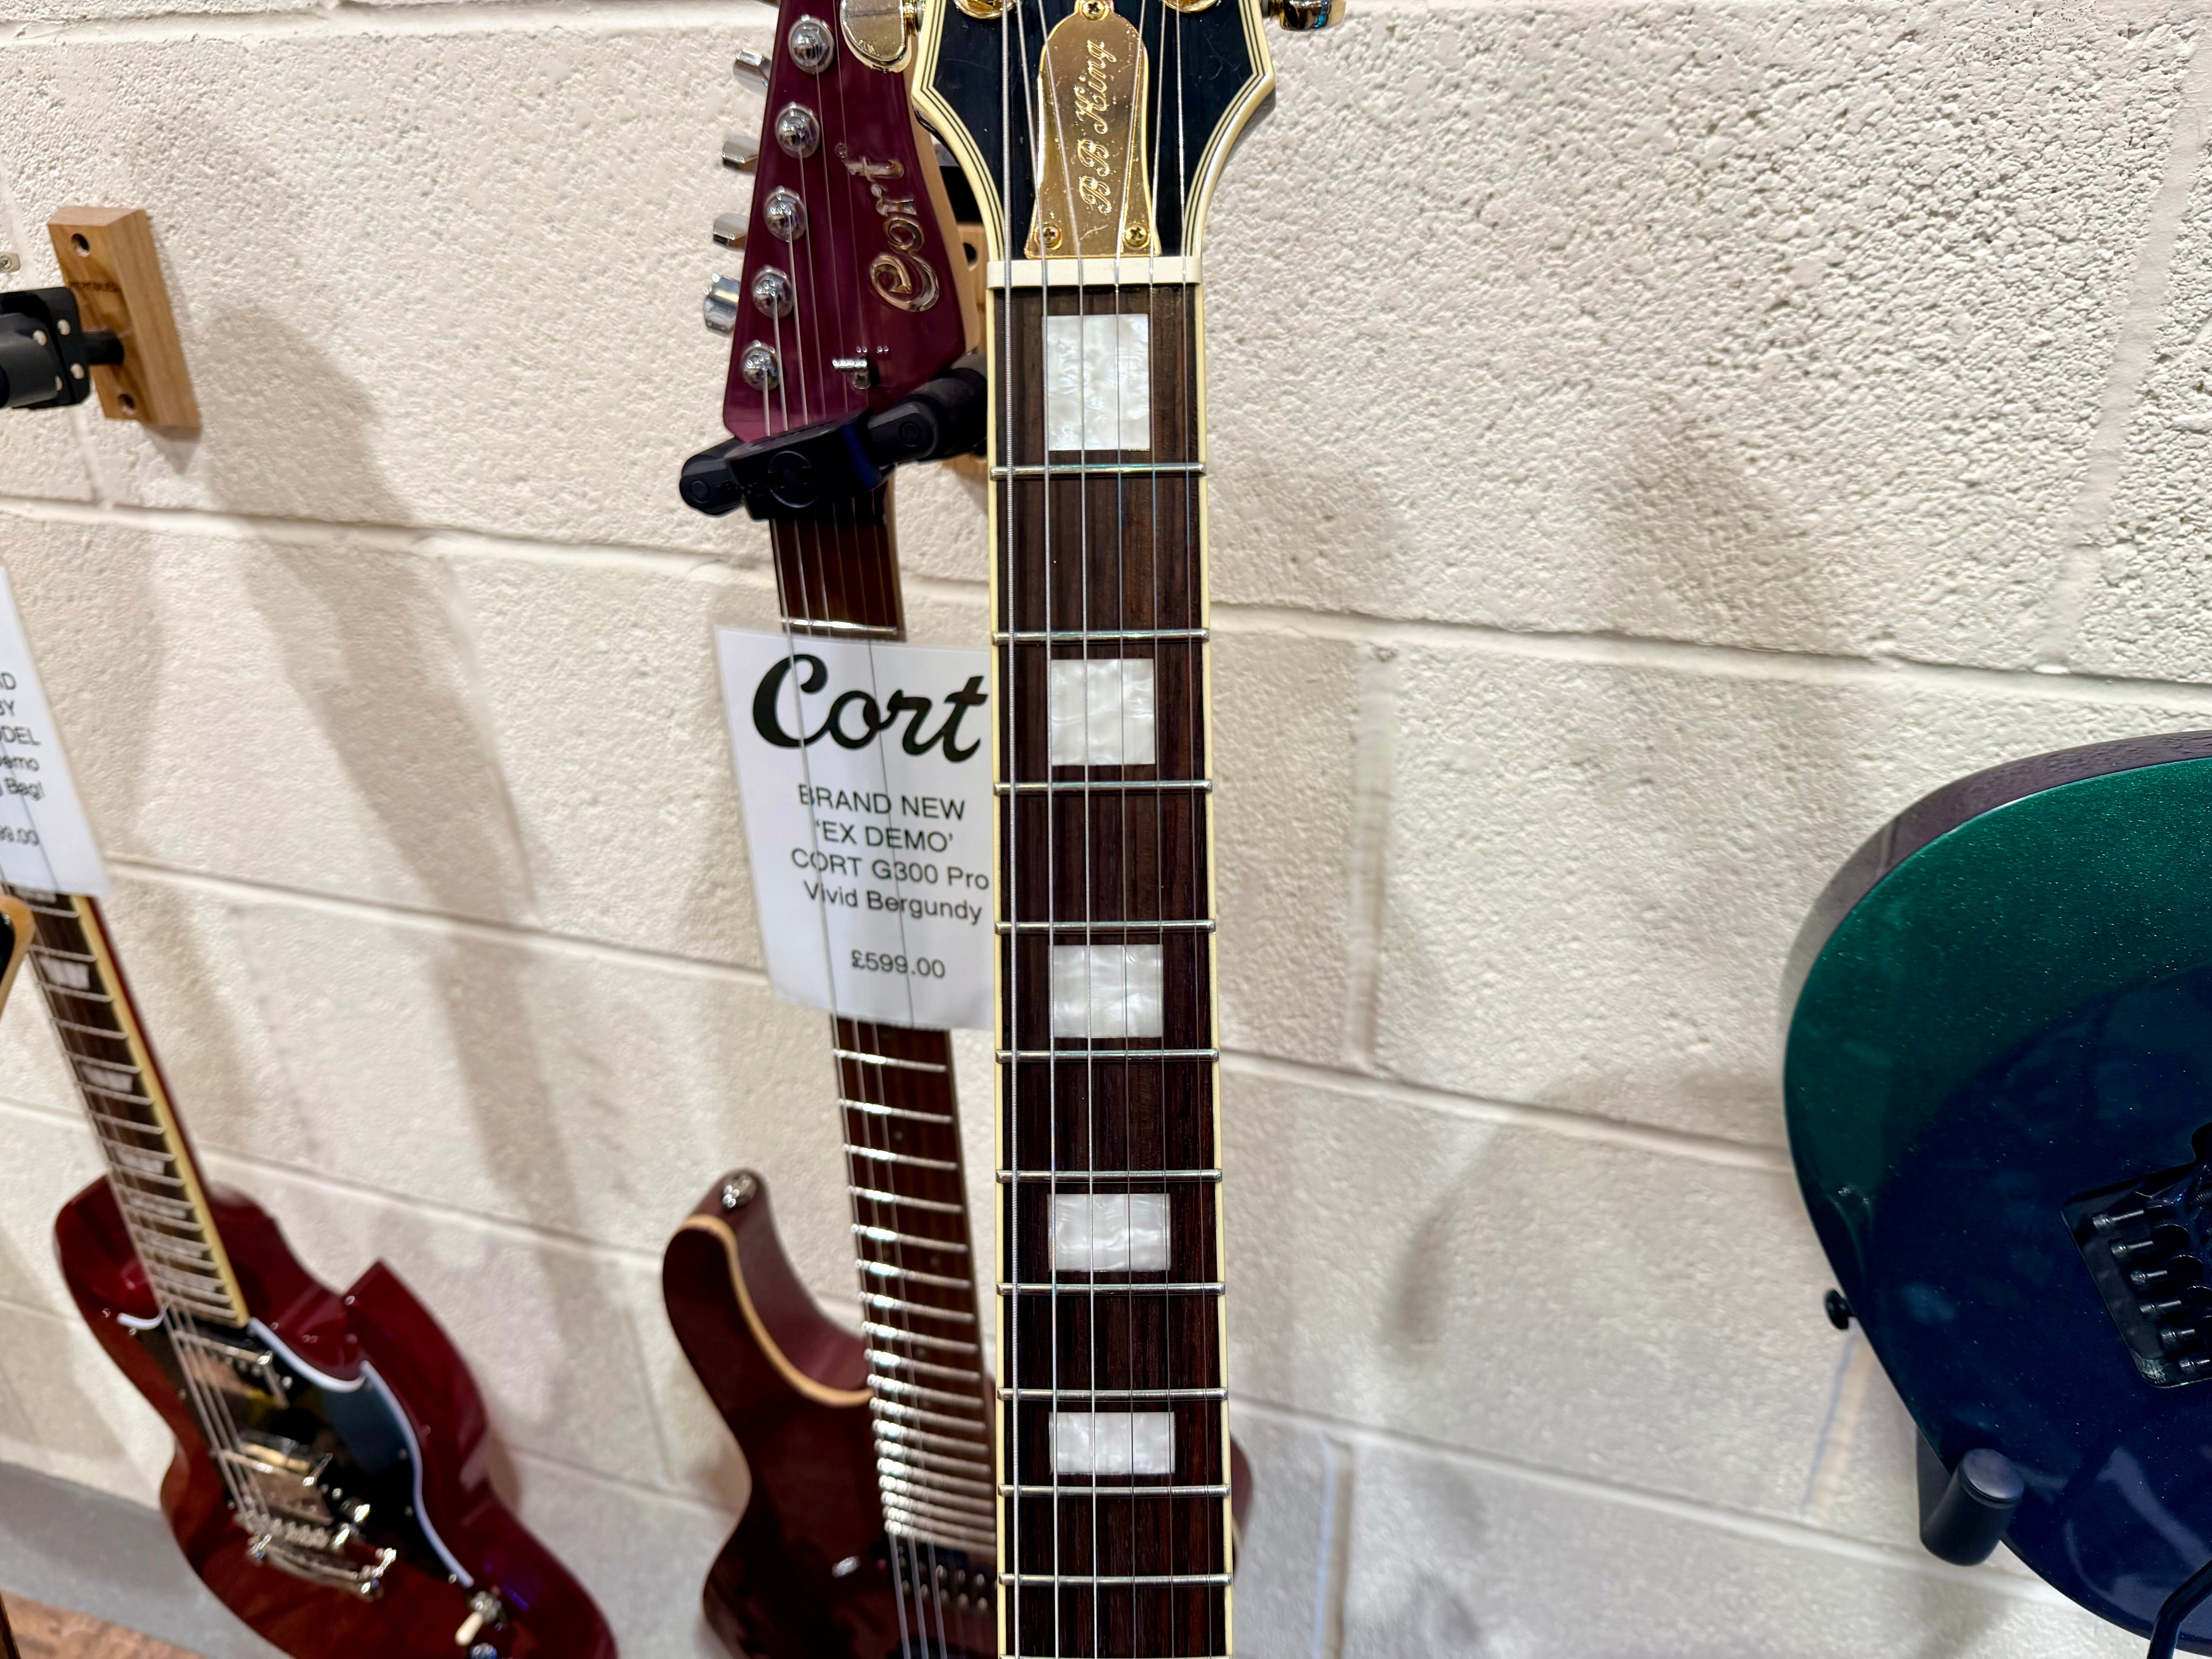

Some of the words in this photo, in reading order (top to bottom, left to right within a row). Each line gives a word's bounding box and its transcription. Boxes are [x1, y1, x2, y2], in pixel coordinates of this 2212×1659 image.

[1073, 40, 1117, 134] King
[844, 156, 940, 312] Cort
[0, 672, 17, 690] D
[752, 654, 989, 763] Cort
[0, 725, 41, 746] DEL
[799, 783, 891, 814] BRAND
[901, 795, 965, 821] NEW
[792, 848, 862, 876] CORT
[872, 859, 938, 884] G300
[947, 866, 989, 890] Pro
[804, 879, 858, 908] Vivid
[867, 890, 982, 925] Bergundy
[851, 950, 946, 978] £599.00
